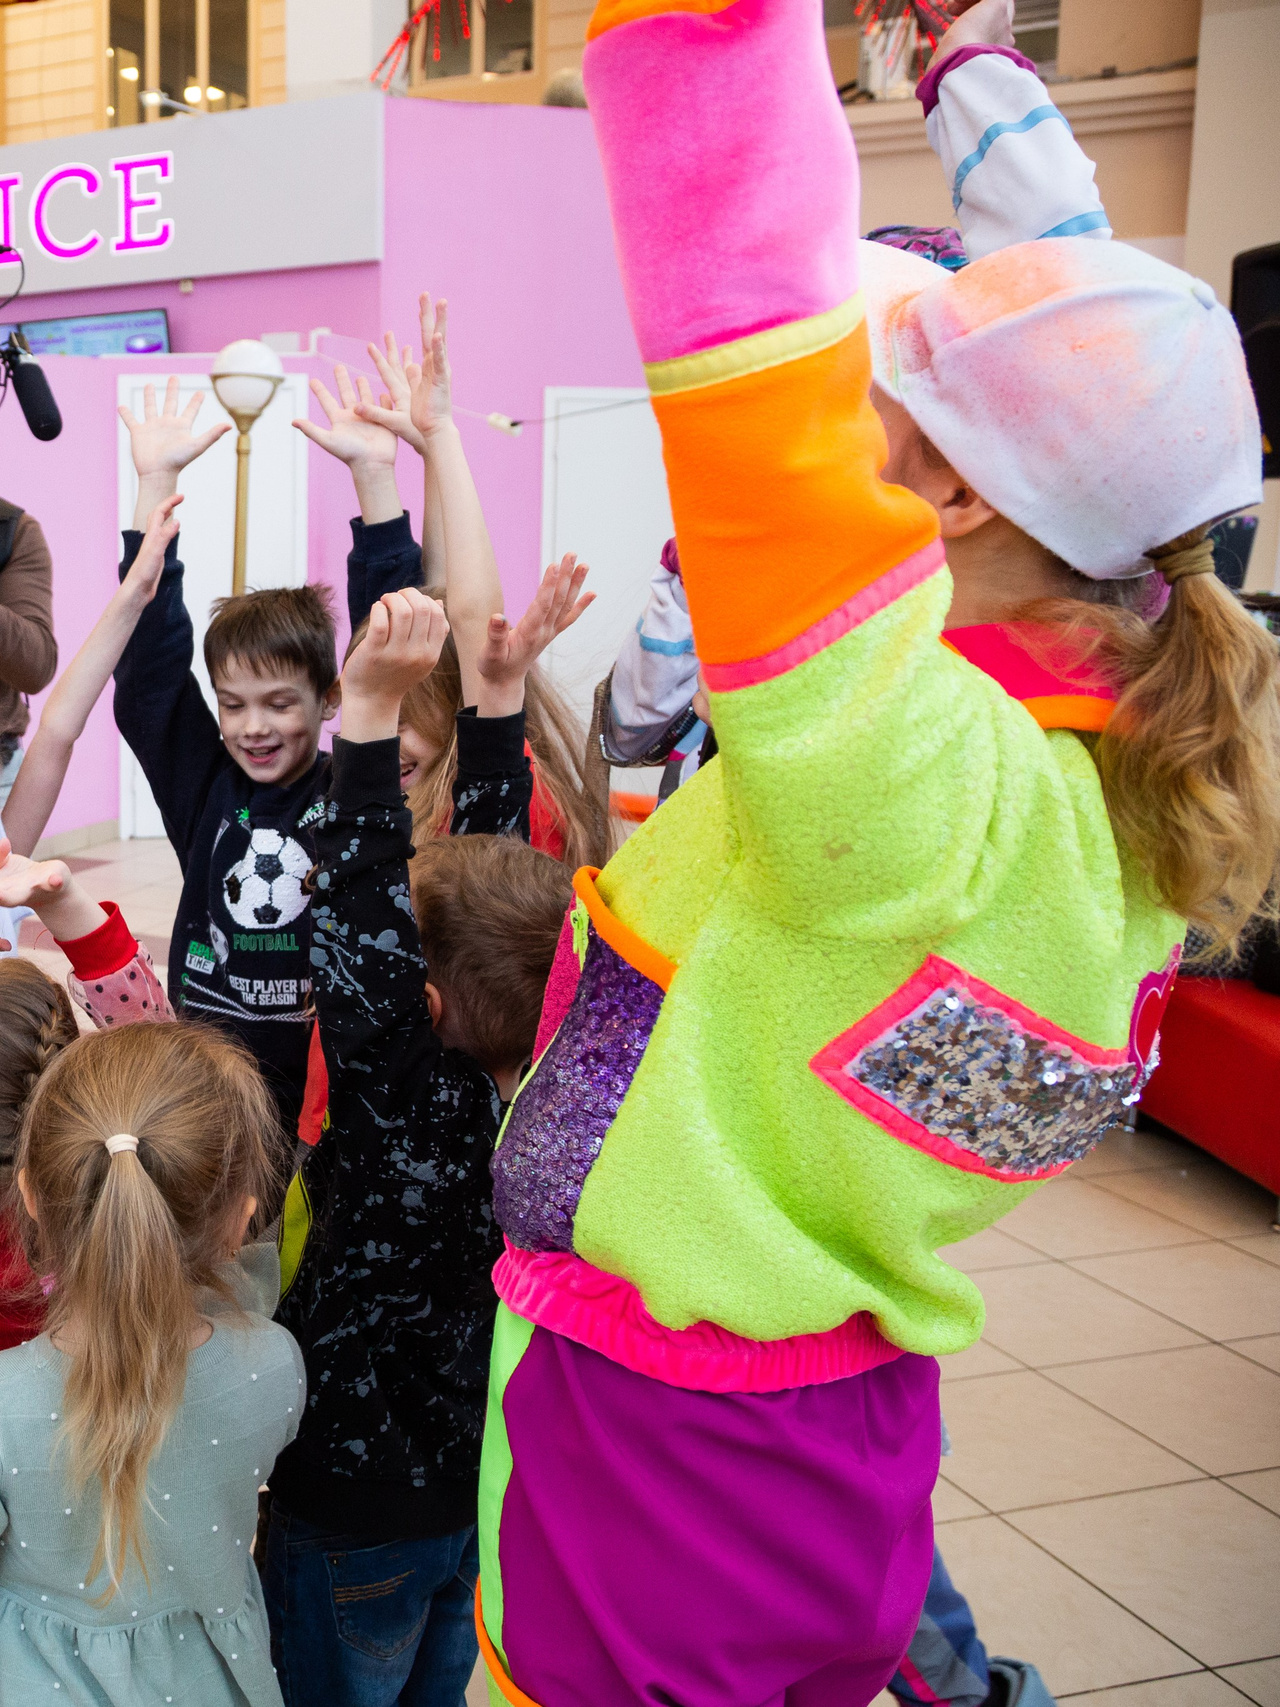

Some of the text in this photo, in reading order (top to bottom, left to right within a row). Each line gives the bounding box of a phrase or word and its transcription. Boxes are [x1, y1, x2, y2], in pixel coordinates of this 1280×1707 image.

[189, 940, 216, 962] GOAL
[233, 934, 299, 951] FOOTBALL
[188, 954, 212, 972] TIME
[253, 980, 298, 994] PLAYER
[241, 991, 297, 1005] THE SEASON
